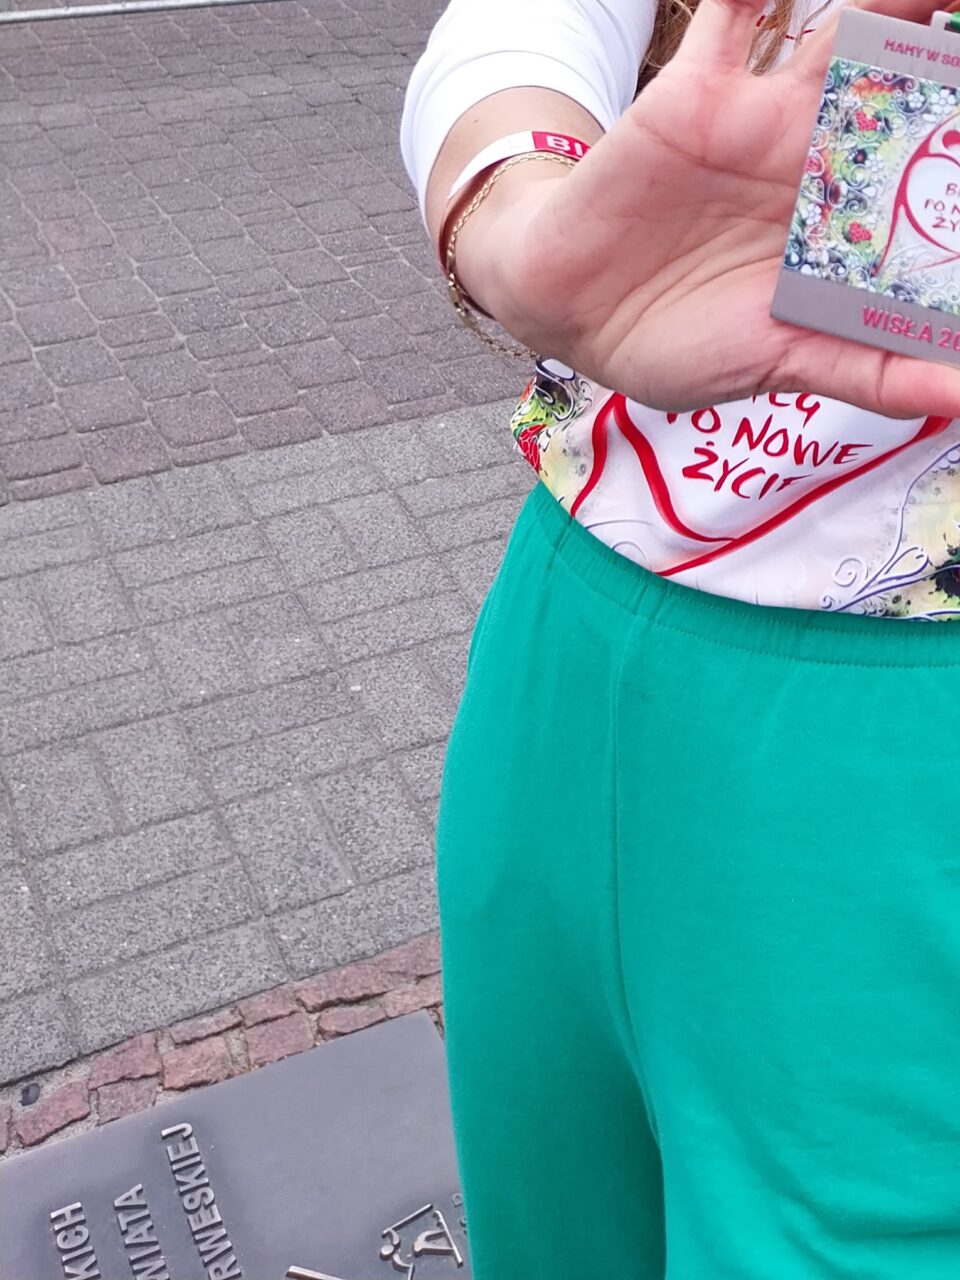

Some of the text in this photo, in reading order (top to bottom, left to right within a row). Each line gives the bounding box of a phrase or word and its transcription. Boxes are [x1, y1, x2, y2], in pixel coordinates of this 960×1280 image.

[883, 38, 925, 59] MAMY
[926, 49, 940, 62] W
[924, 198, 946, 212] PO
[861, 304, 933, 344] WISŁA
[666, 406, 874, 468] O NOWE
[161, 1122, 242, 1280] RWESKIEJ
[50, 1201, 102, 1280] KICH
